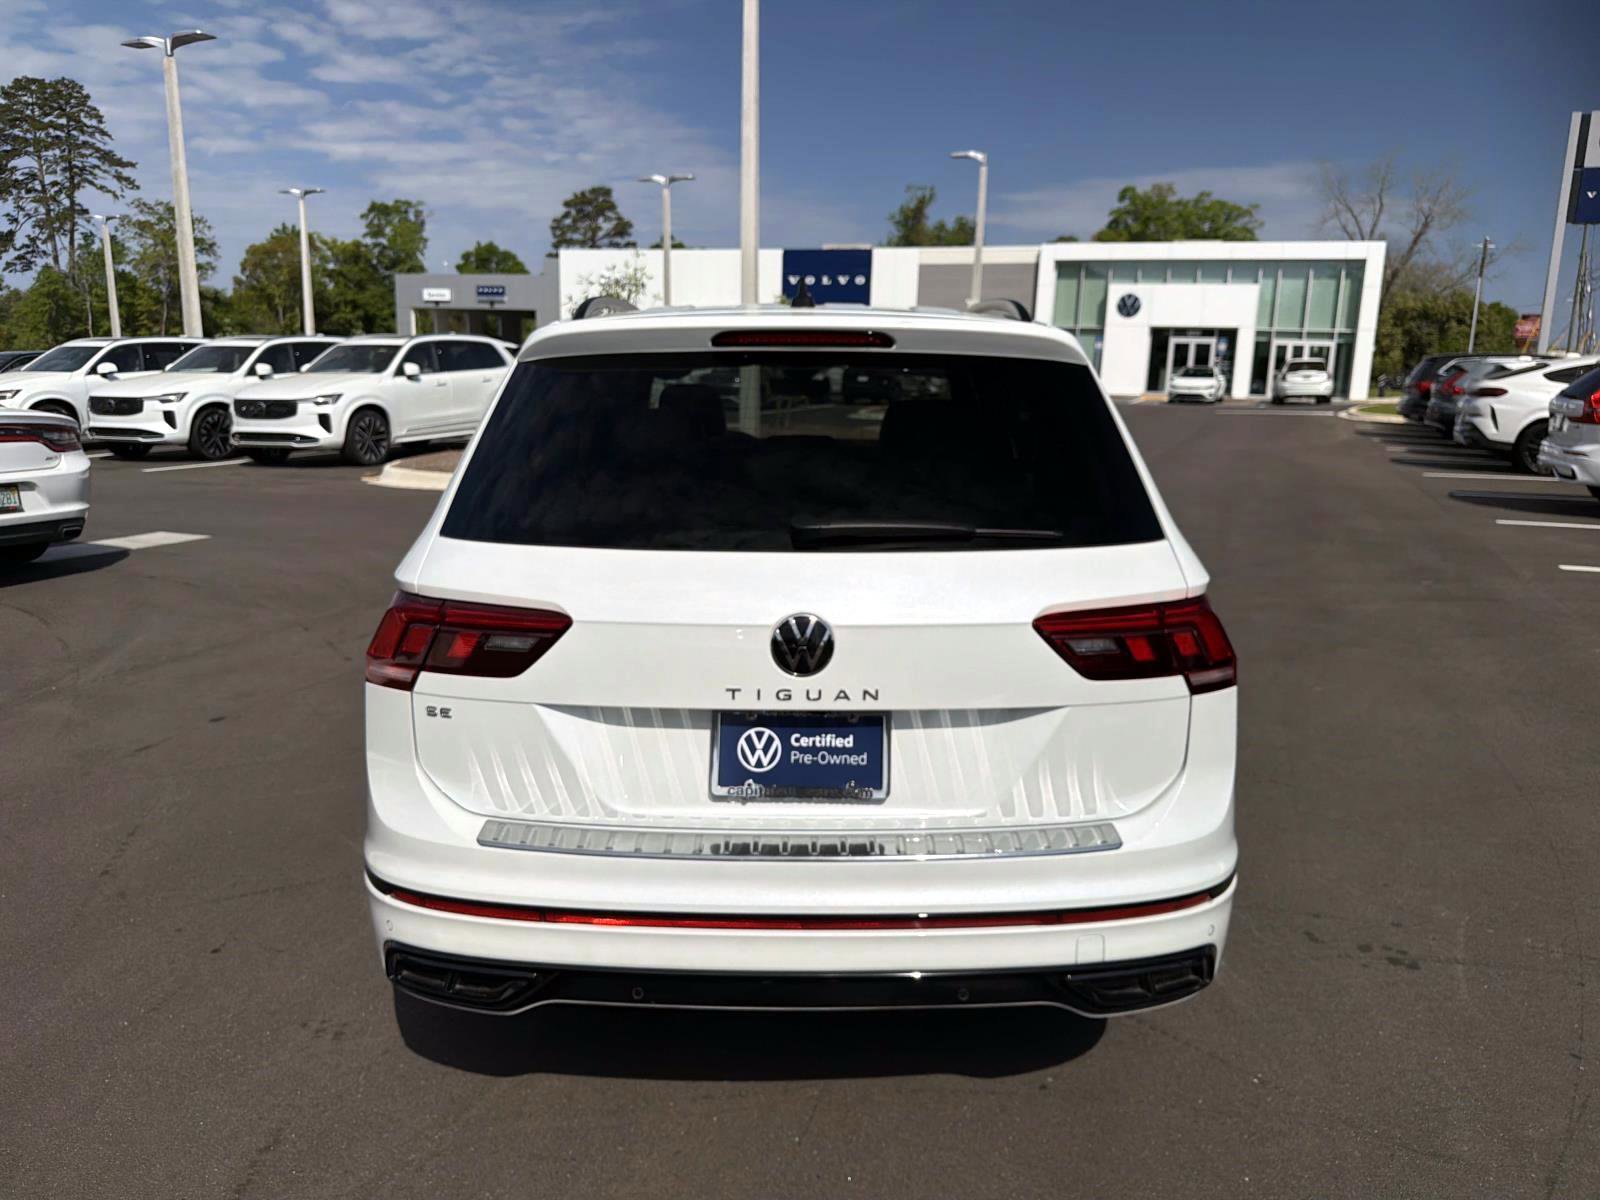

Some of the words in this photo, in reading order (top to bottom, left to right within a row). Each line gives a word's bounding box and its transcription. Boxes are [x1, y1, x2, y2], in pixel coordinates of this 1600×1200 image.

[788, 274, 866, 286] VOLVO
[725, 687, 881, 701] TIGUAN
[790, 733, 854, 748] Certified
[790, 751, 868, 766] Pre-Owned
